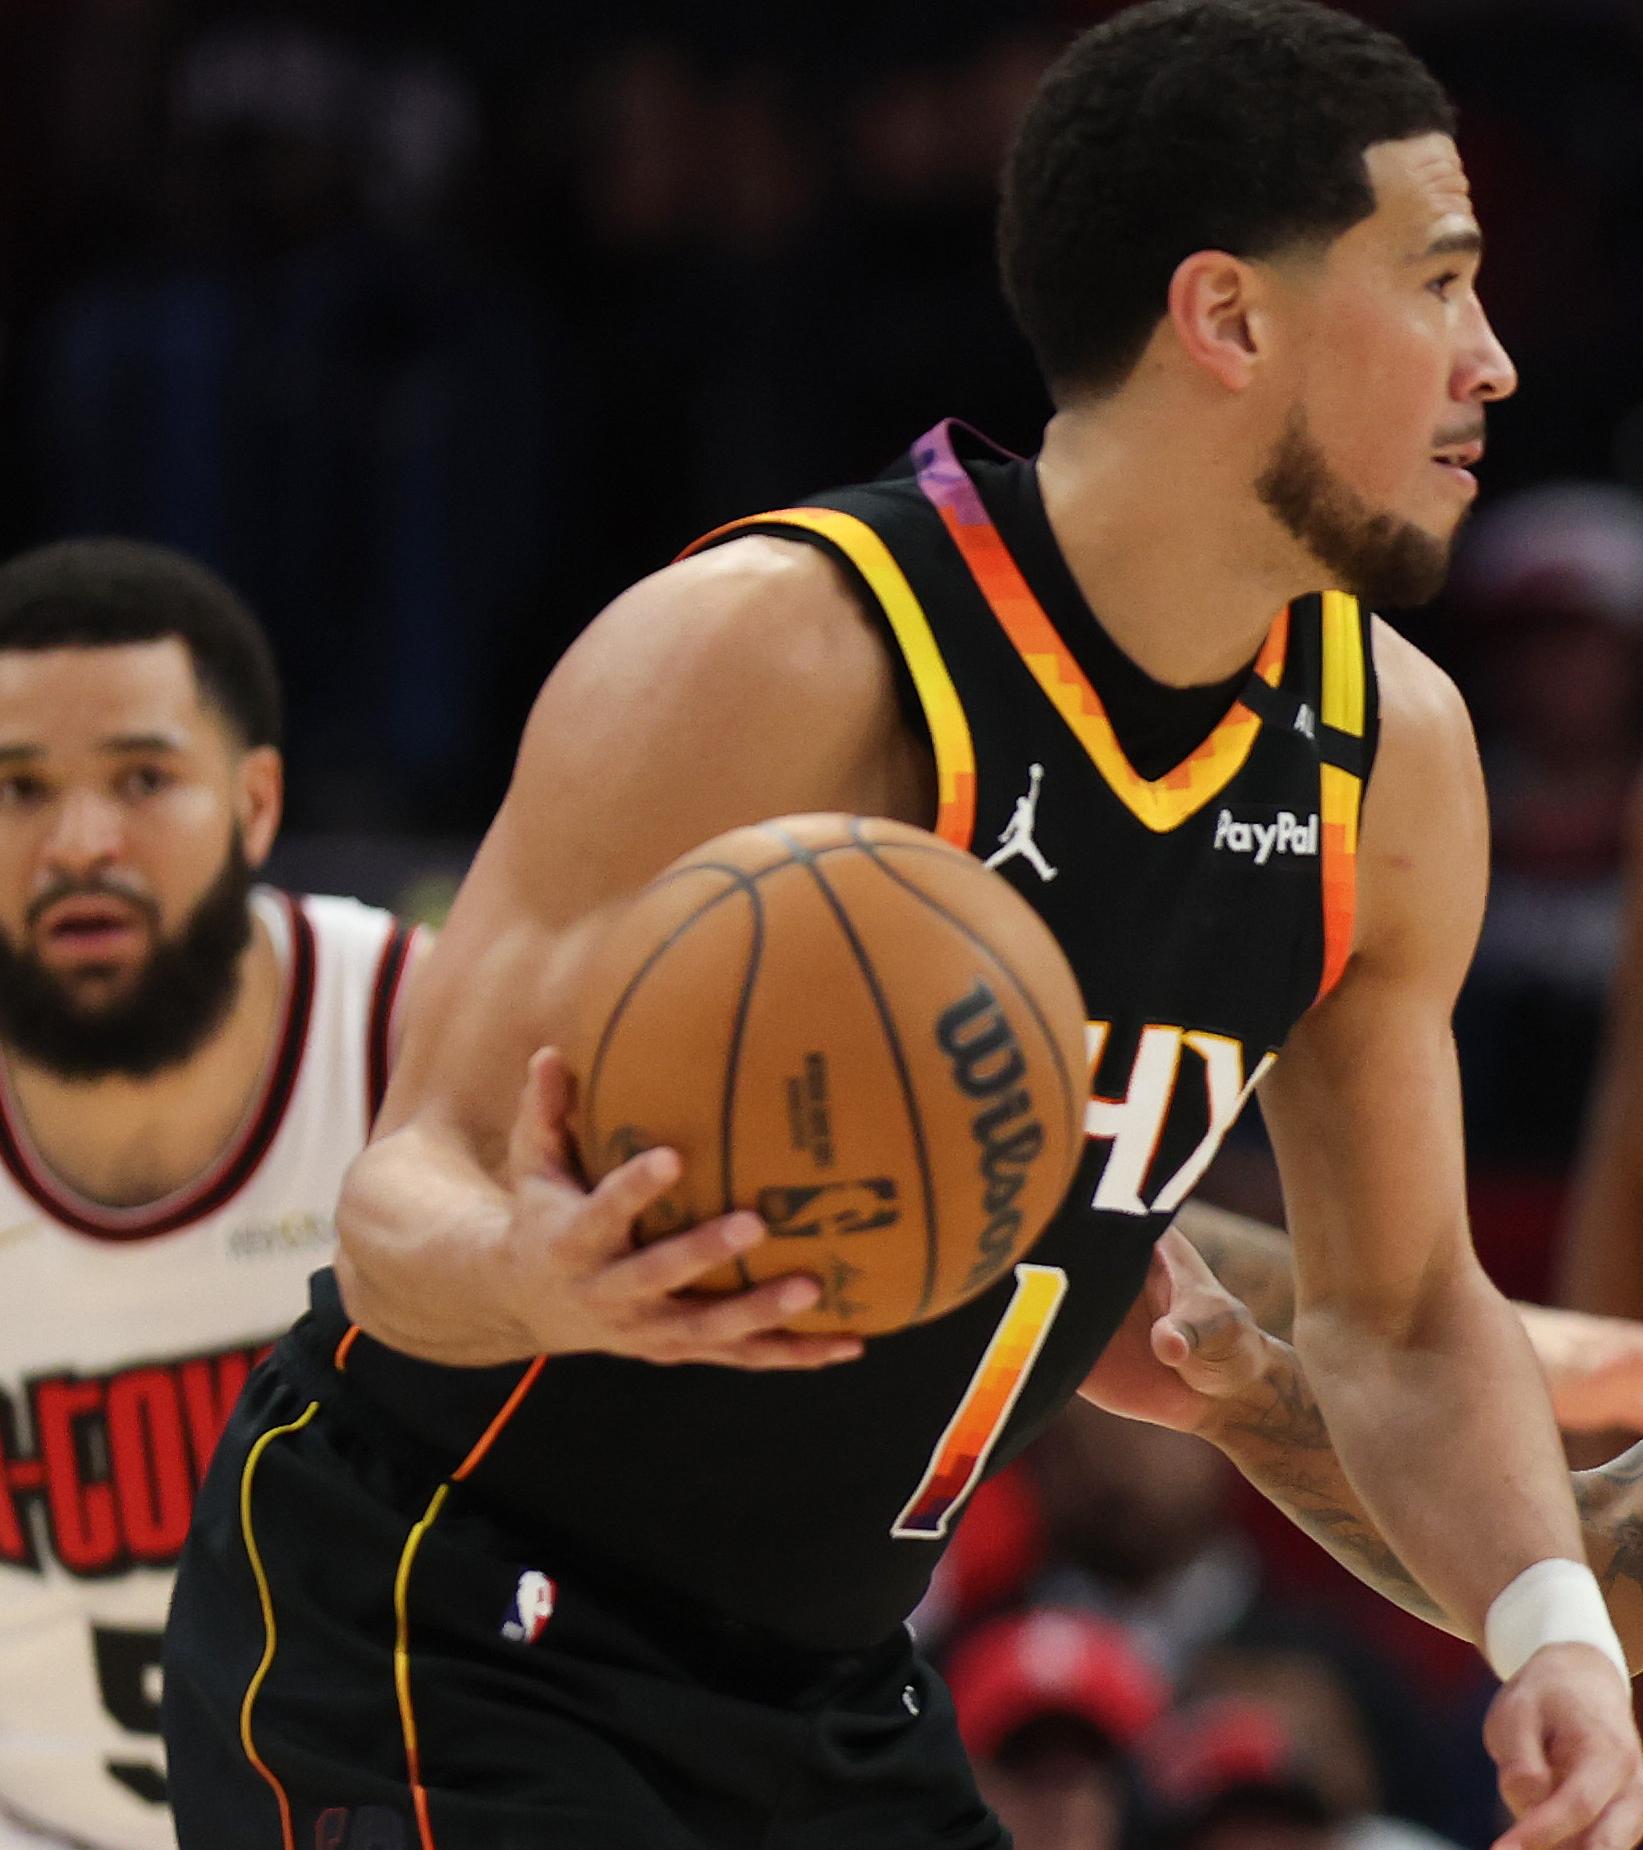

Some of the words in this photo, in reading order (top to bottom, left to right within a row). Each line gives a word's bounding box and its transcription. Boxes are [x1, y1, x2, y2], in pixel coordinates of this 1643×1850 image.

[1213, 808, 1319, 866] PayPal
[936, 976, 1045, 1297] Wilson
[889, 1262, 1069, 1540] 1
